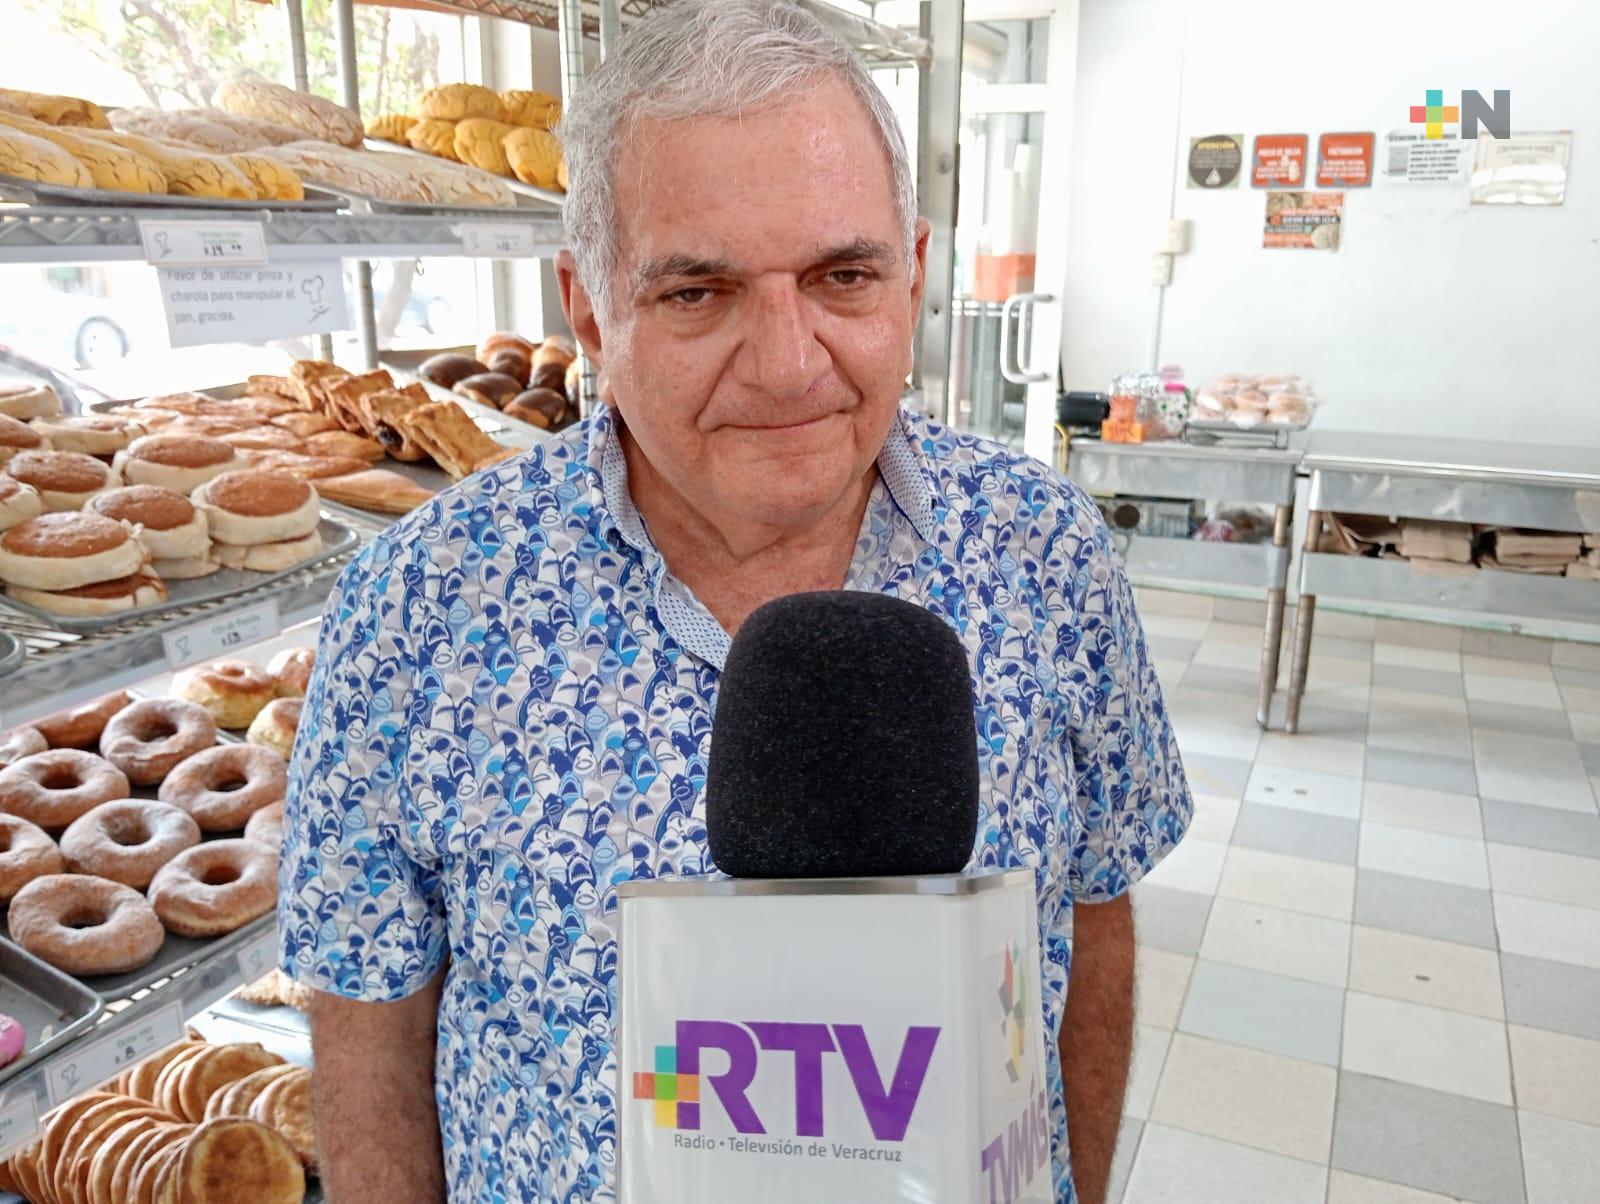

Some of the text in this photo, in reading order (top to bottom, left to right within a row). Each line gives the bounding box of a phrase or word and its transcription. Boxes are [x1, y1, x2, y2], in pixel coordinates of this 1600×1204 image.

[167, 270, 293, 283] Favor de utilizar pinza y
[170, 289, 295, 304] charola para manipular el
[676, 1019, 942, 1142] RTV
[674, 1134, 903, 1163] Radio Televisión de Veracruz
